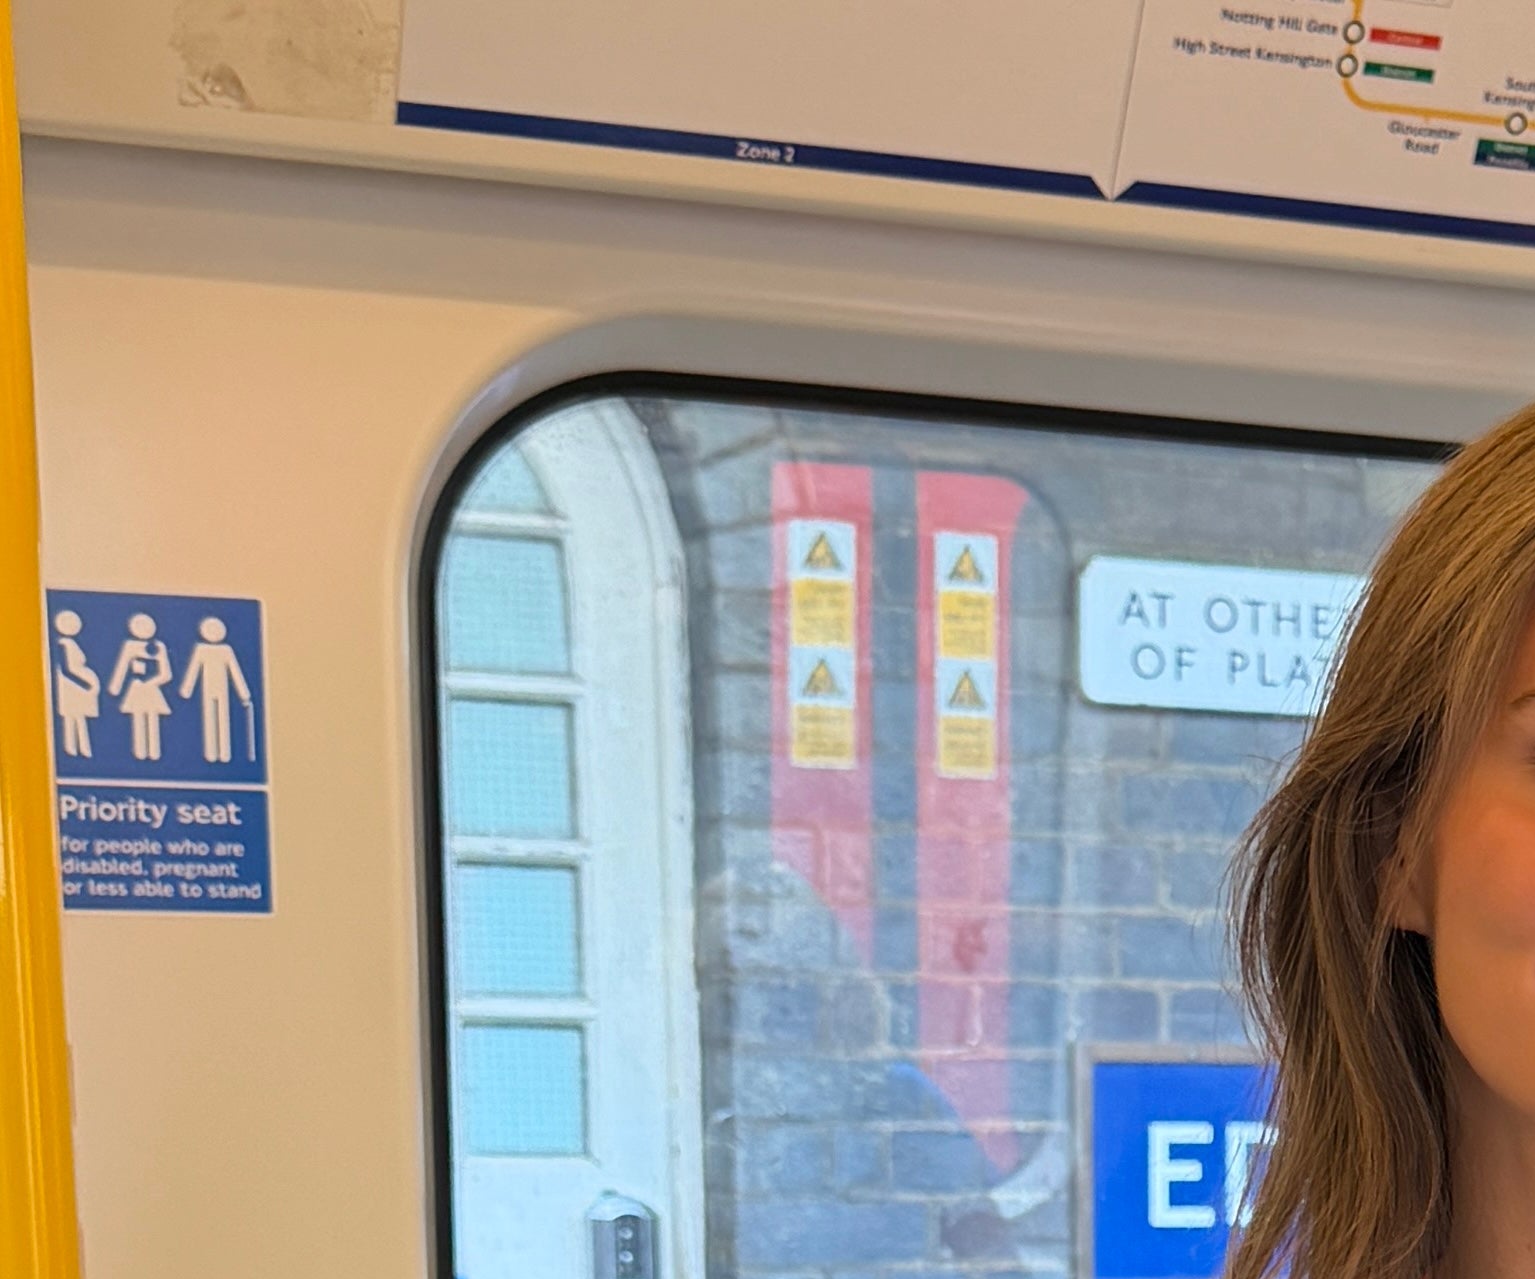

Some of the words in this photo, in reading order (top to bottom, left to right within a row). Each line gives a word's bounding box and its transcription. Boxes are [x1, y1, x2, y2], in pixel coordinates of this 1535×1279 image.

[1220, 8, 1275, 29] Notting
[1278, 14, 1303, 32] Hill
[1306, 18, 1338, 35] Gate
[1174, 36, 1206, 54] High
[1208, 41, 1251, 59] Street
[1255, 46, 1334, 70] Kensington
[735, 140, 781, 163] Zone
[1118, 590, 1175, 629] AT
[1129, 642, 1197, 682] OF
[60, 793, 168, 829] Priority
[176, 800, 244, 827] seat
[61, 835, 90, 854] for
[93, 838, 163, 858] people
[167, 839, 210, 857] who
[213, 842, 246, 859] are
[153, 861, 240, 881] pregnant
[63, 880, 83, 897] or
[87, 878, 128, 898] less
[132, 878, 175, 899] able
[180, 880, 204, 899] to
[207, 882, 263, 901] stand
